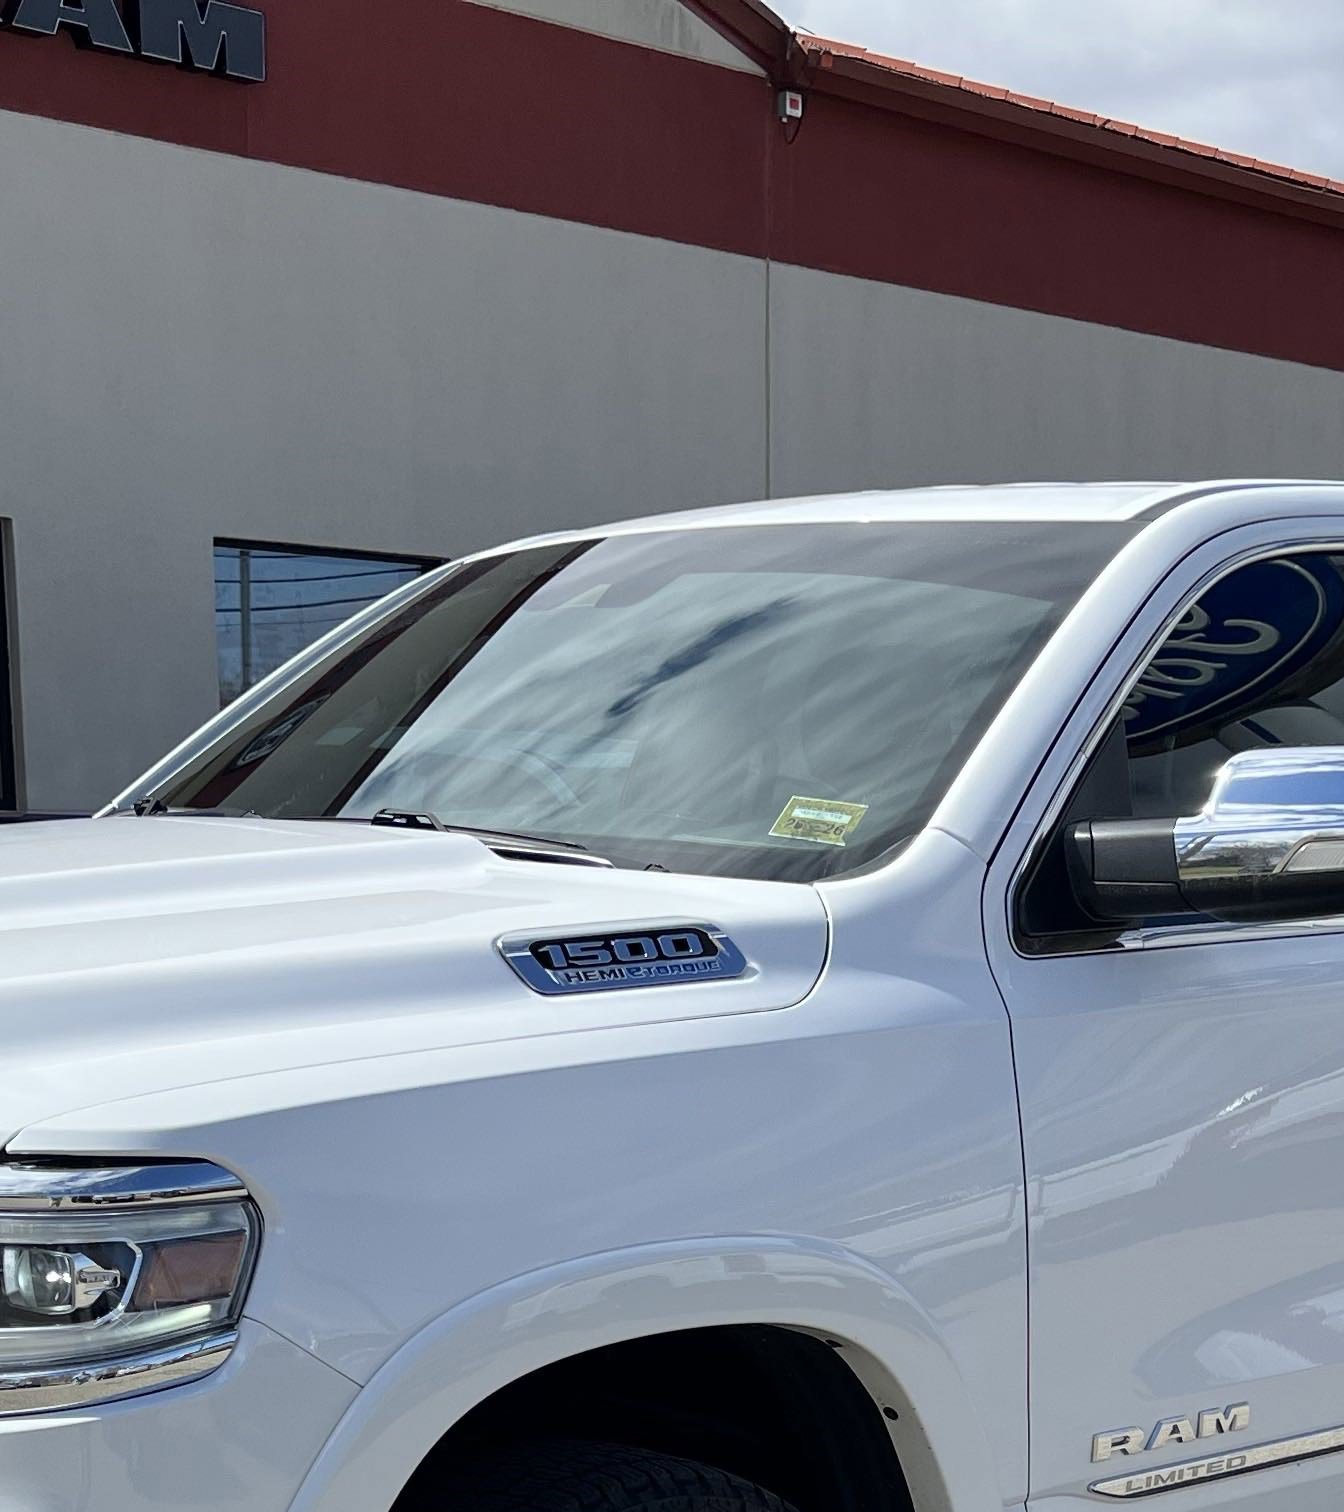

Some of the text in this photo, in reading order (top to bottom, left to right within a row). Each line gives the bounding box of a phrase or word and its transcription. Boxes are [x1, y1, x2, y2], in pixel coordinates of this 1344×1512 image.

[538, 932, 703, 968] 1500
[564, 967, 623, 985] HEMI
[1090, 1401, 1250, 1463] RAM
[1125, 1454, 1247, 1493] LIMITED
